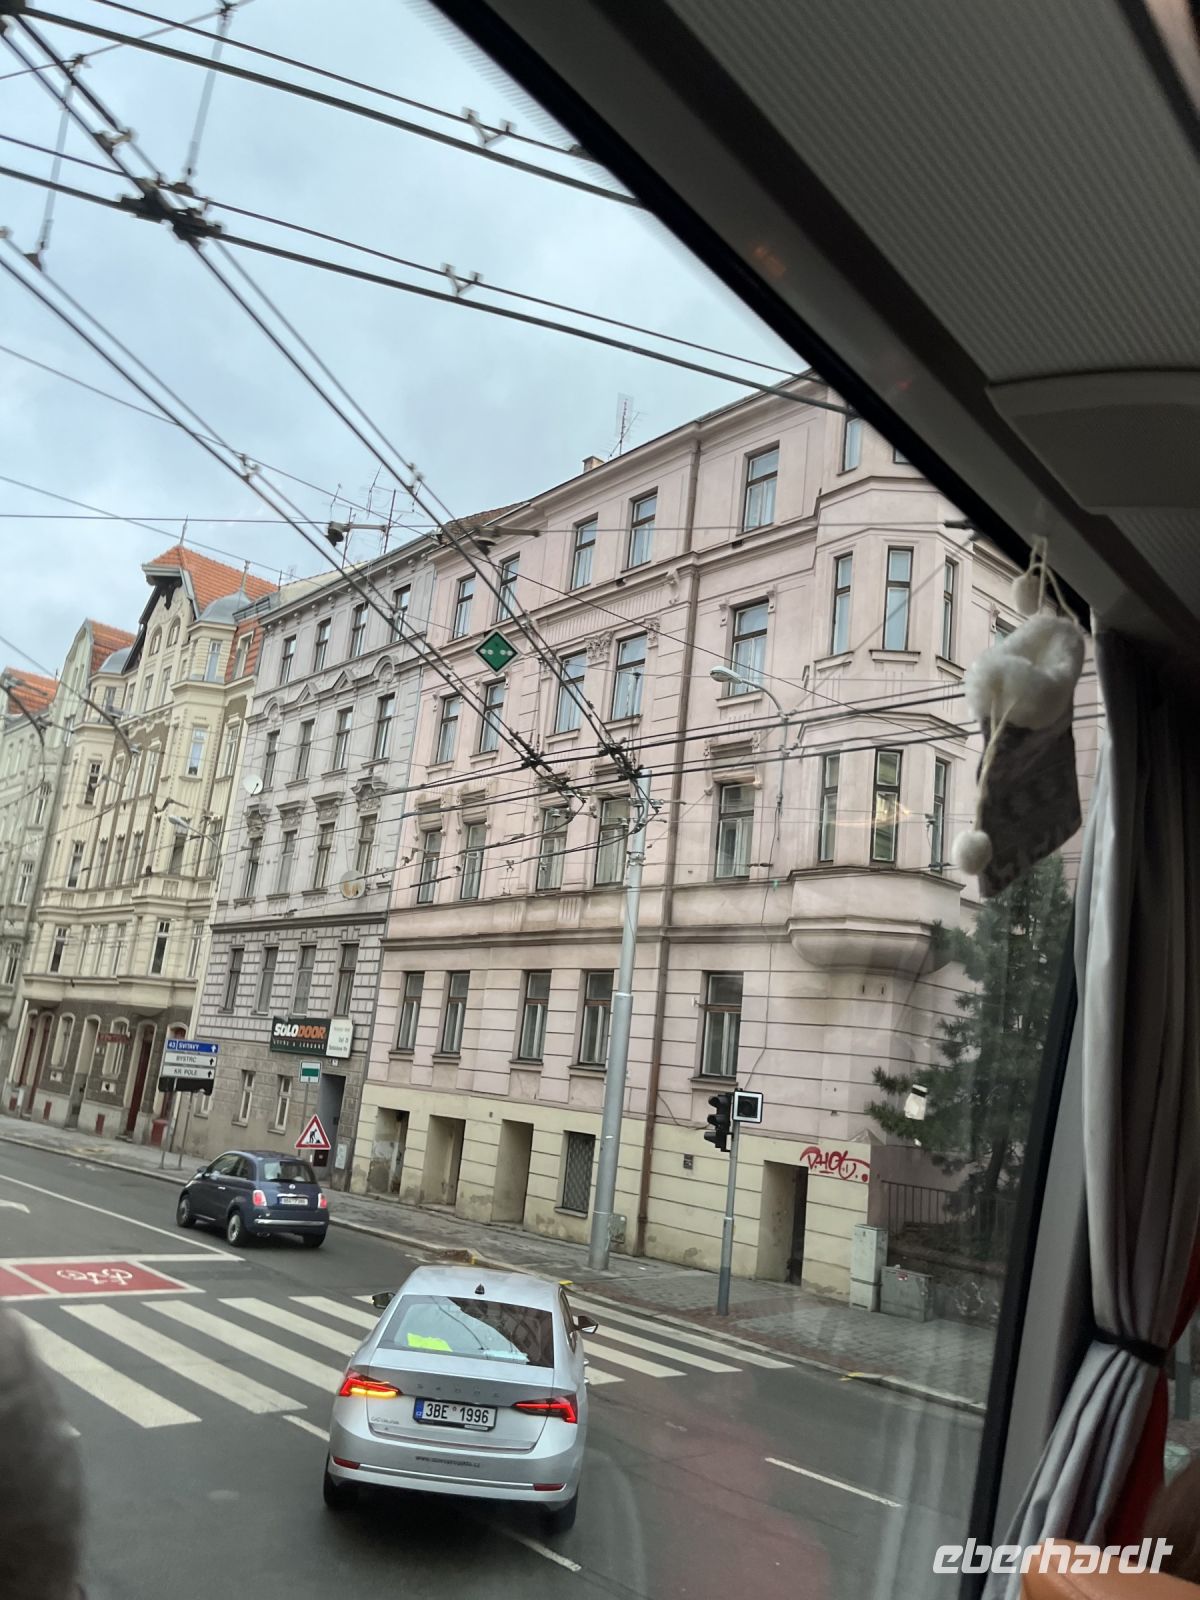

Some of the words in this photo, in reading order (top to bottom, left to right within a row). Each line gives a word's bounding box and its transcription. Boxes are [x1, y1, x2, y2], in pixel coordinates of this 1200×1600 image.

[273, 1022, 326, 1039] SOLODOOR
[425, 1403, 449, 1420] 3BE
[460, 1407, 489, 1424] 1996
